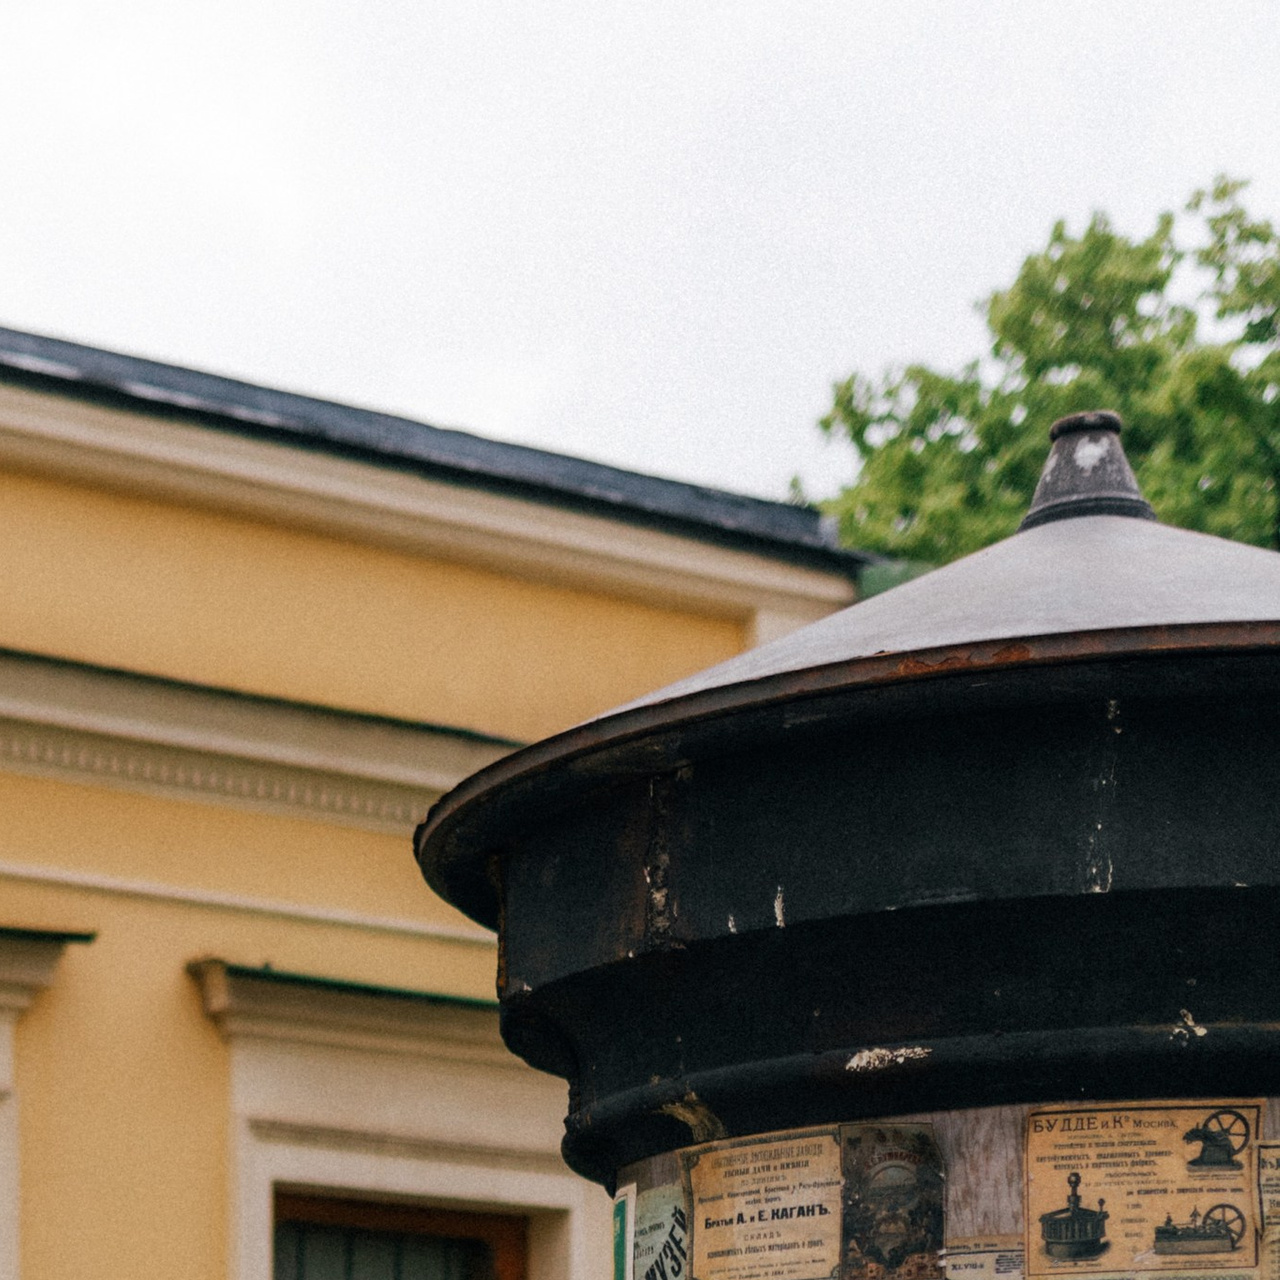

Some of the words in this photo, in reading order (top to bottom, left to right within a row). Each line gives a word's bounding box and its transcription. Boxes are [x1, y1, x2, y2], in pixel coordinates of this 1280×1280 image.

[1034, 1117, 1098, 1133] БУДДЕ
[1101, 1120, 1109, 1129] и
[736, 1212, 748, 1224] А.
[758, 1210, 768, 1221] Е.
[771, 1204, 832, 1220] КАГАНЪ.
